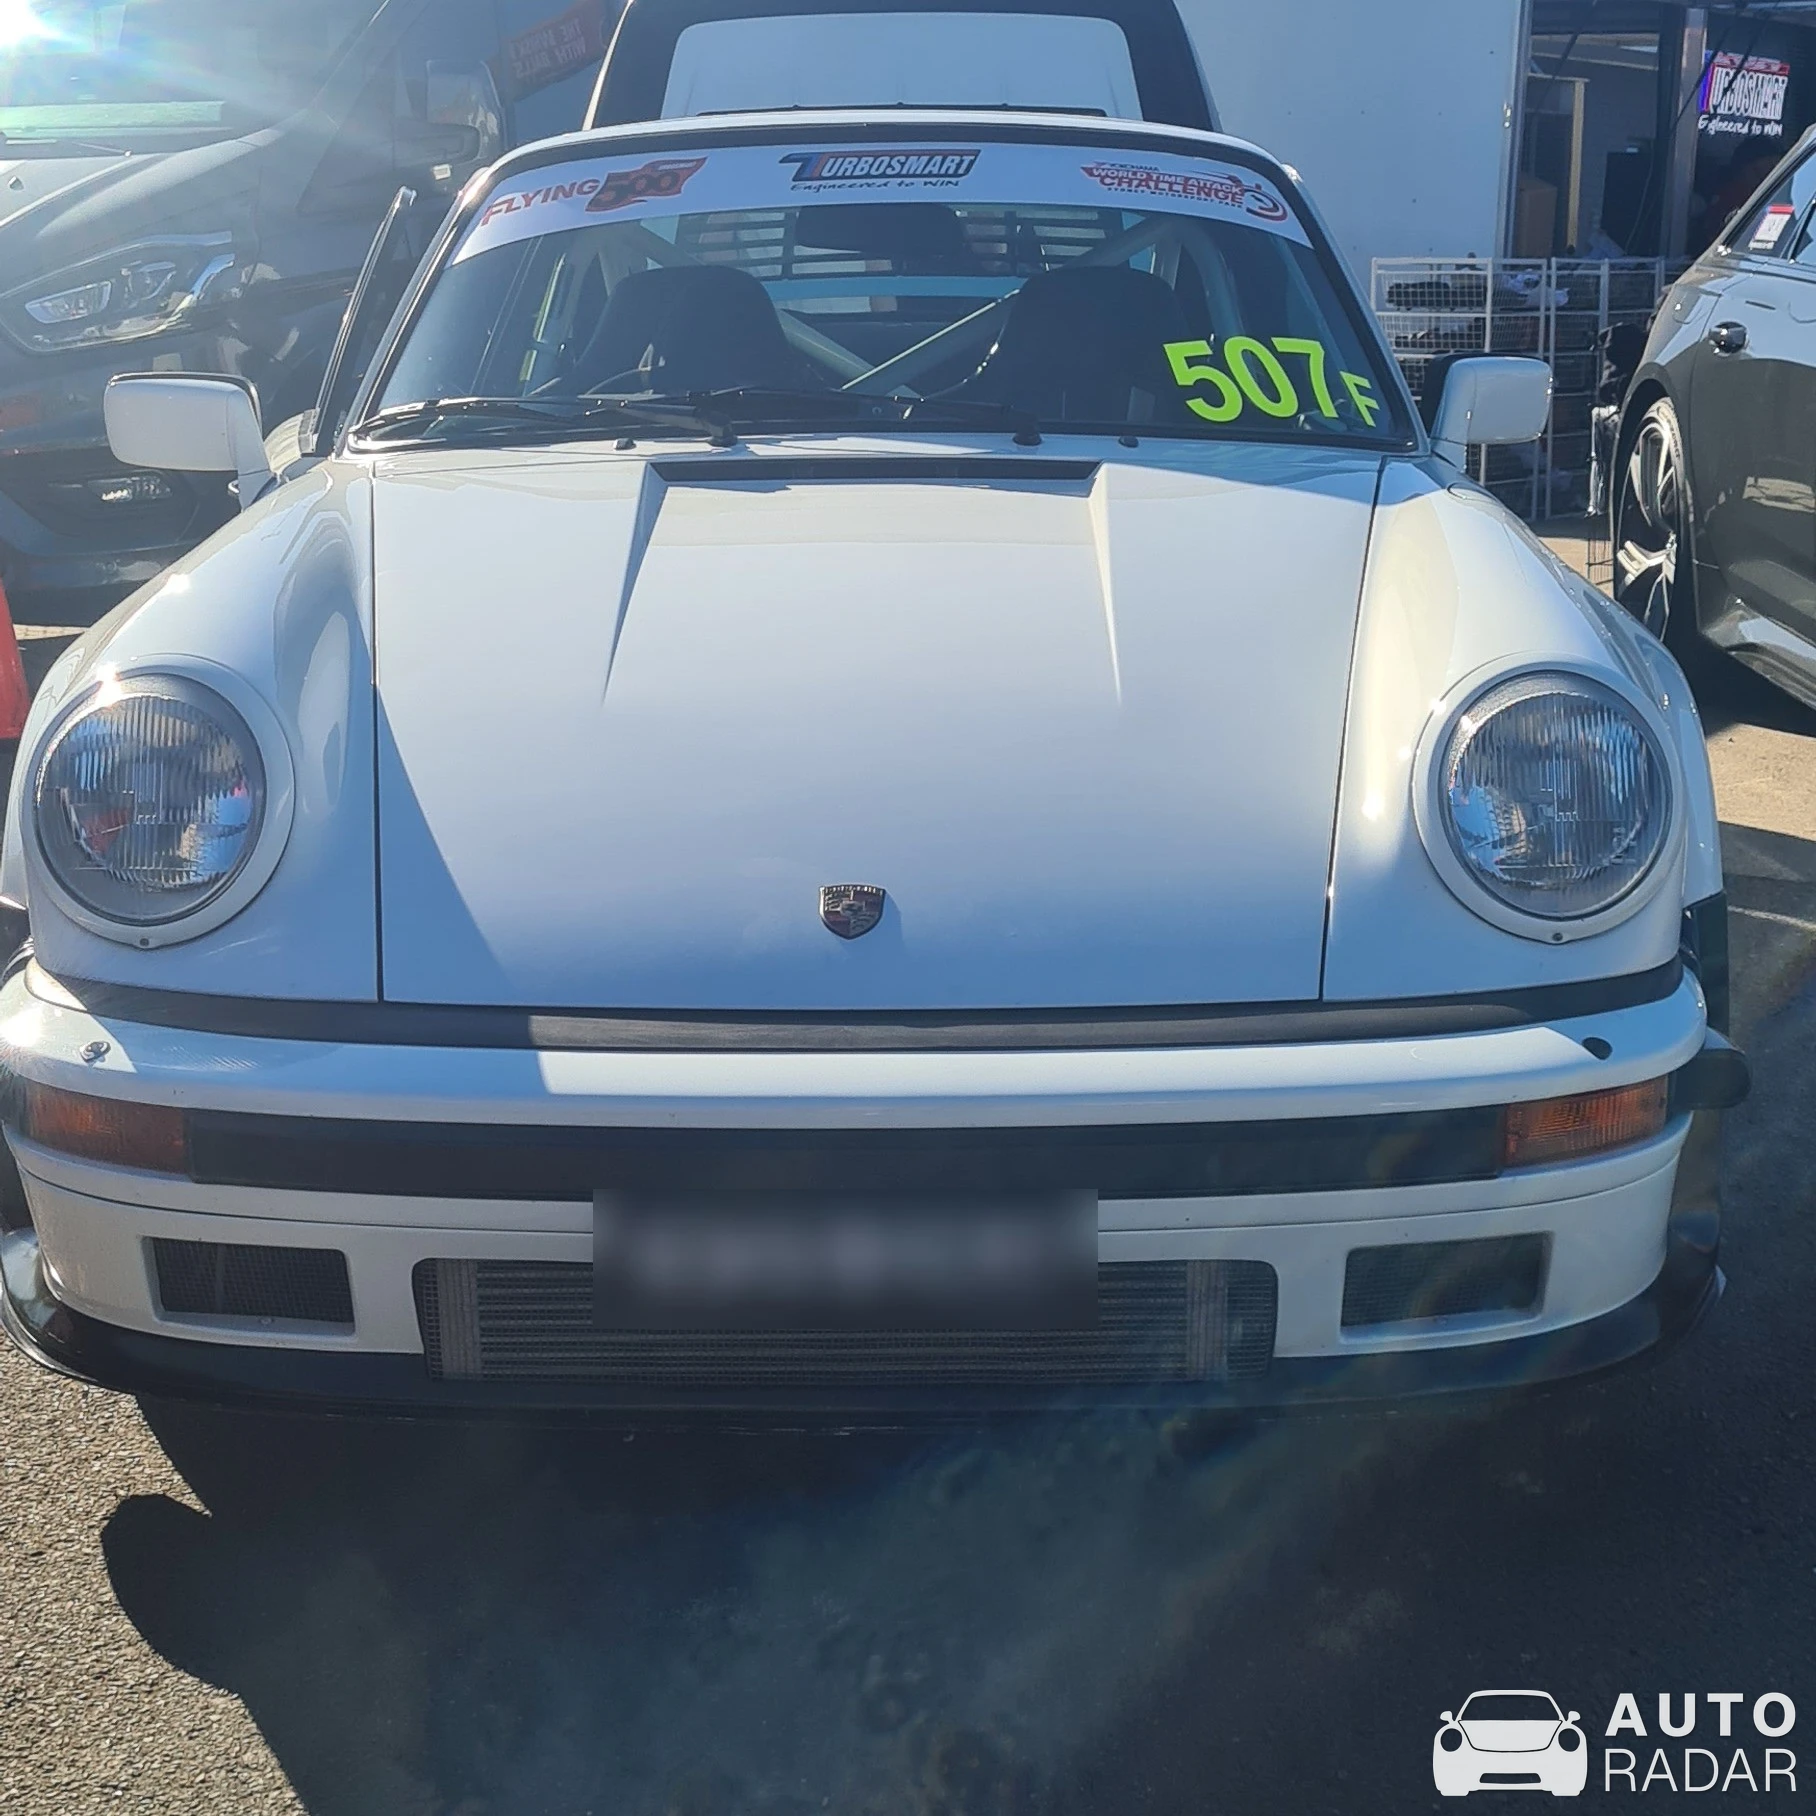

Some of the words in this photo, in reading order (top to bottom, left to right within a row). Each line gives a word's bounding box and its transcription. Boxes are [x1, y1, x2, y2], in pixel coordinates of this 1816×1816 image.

[1751, 120, 1763, 135] to
[779, 149, 981, 181] TURBOSMART
[790, 180, 890, 193] Engineered
[897, 180, 914, 188] to
[922, 179, 959, 188] WIN
[1092, 168, 1147, 180] WORLD
[1151, 173, 1185, 186] TIME
[1187, 178, 1242, 195] ATTACK
[1099, 176, 1244, 204] CHALLENGE
[480, 178, 600, 227] FLYING
[1163, 336, 1339, 422] 507
[1340, 371, 1380, 428] F
